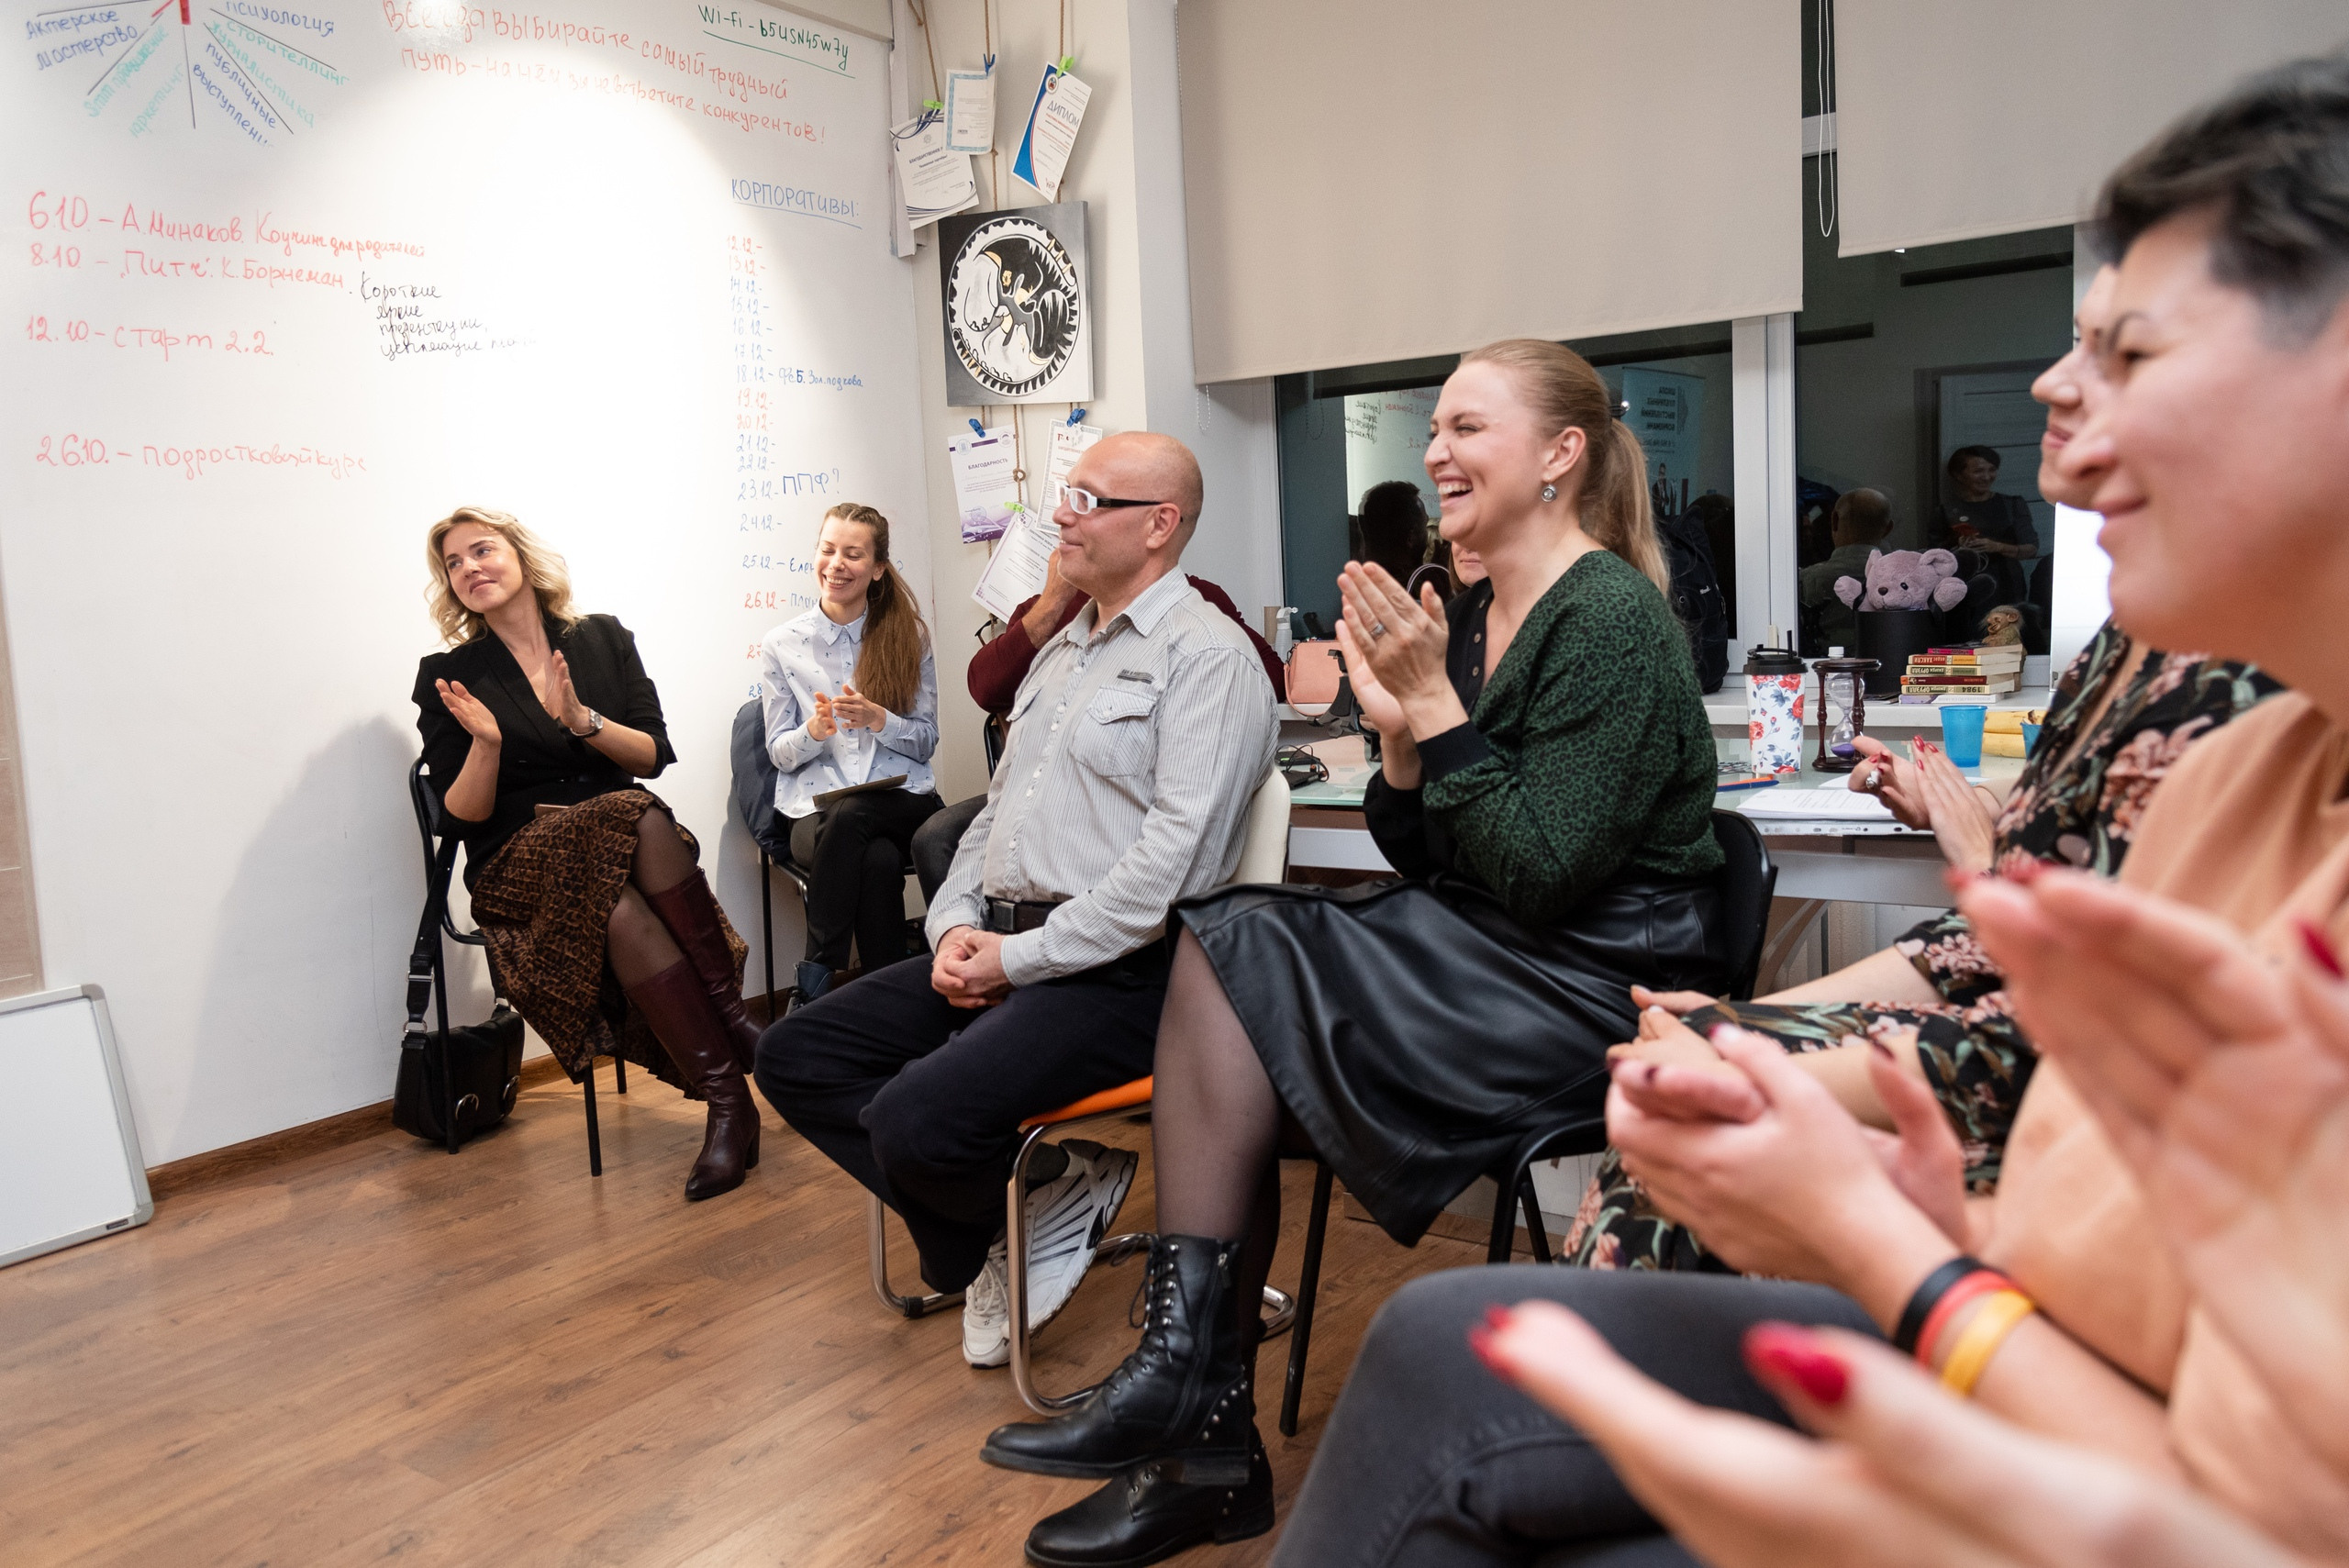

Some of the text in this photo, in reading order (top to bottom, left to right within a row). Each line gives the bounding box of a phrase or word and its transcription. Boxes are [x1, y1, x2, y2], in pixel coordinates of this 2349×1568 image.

[641, 40, 706, 78] самый
[708, 67, 788, 103] трудный
[703, 103, 826, 145] конкурентов!
[1046, 100, 1080, 128] ДИПЛОМ
[968, 458, 1008, 471] БЛАГОДАРНОСТЬ
